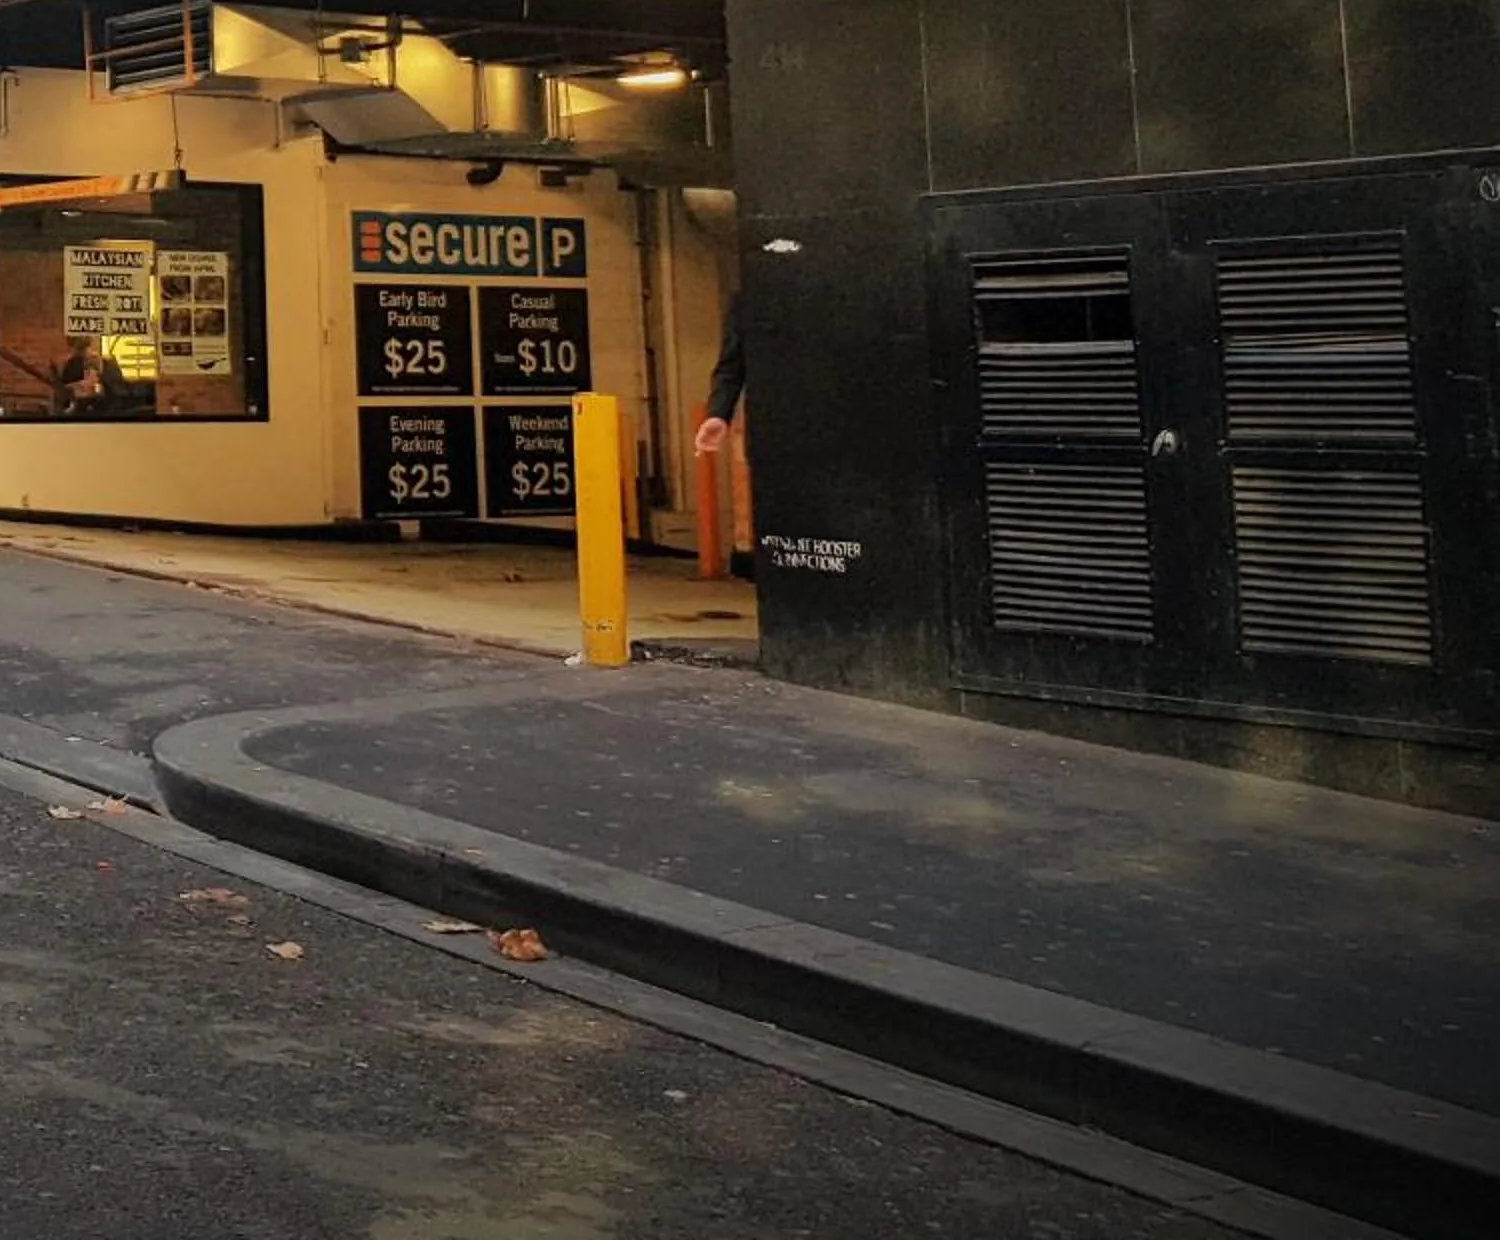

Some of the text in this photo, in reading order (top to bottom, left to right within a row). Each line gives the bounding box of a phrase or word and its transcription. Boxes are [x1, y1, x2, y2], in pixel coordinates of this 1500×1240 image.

[385, 221, 576, 268] secure P
[71, 250, 144, 268] MALAYSIAN
[82, 273, 133, 289] KITCHEN
[72, 295, 109, 310] FRESH
[379, 290, 447, 310] Early Bird
[510, 292, 556, 310] Casual
[68, 317, 147, 334] MADE DAILY
[387, 311, 441, 330] Parking
[509, 312, 559, 333] Parking
[383, 337, 447, 379] $25
[517, 337, 578, 377] $10
[389, 415, 446, 434] Evening
[508, 415, 570, 431] Weekend
[391, 436, 445, 455] Parking
[515, 434, 565, 454] Parking
[389, 462, 451, 504] $25
[511, 460, 571, 501] $25
